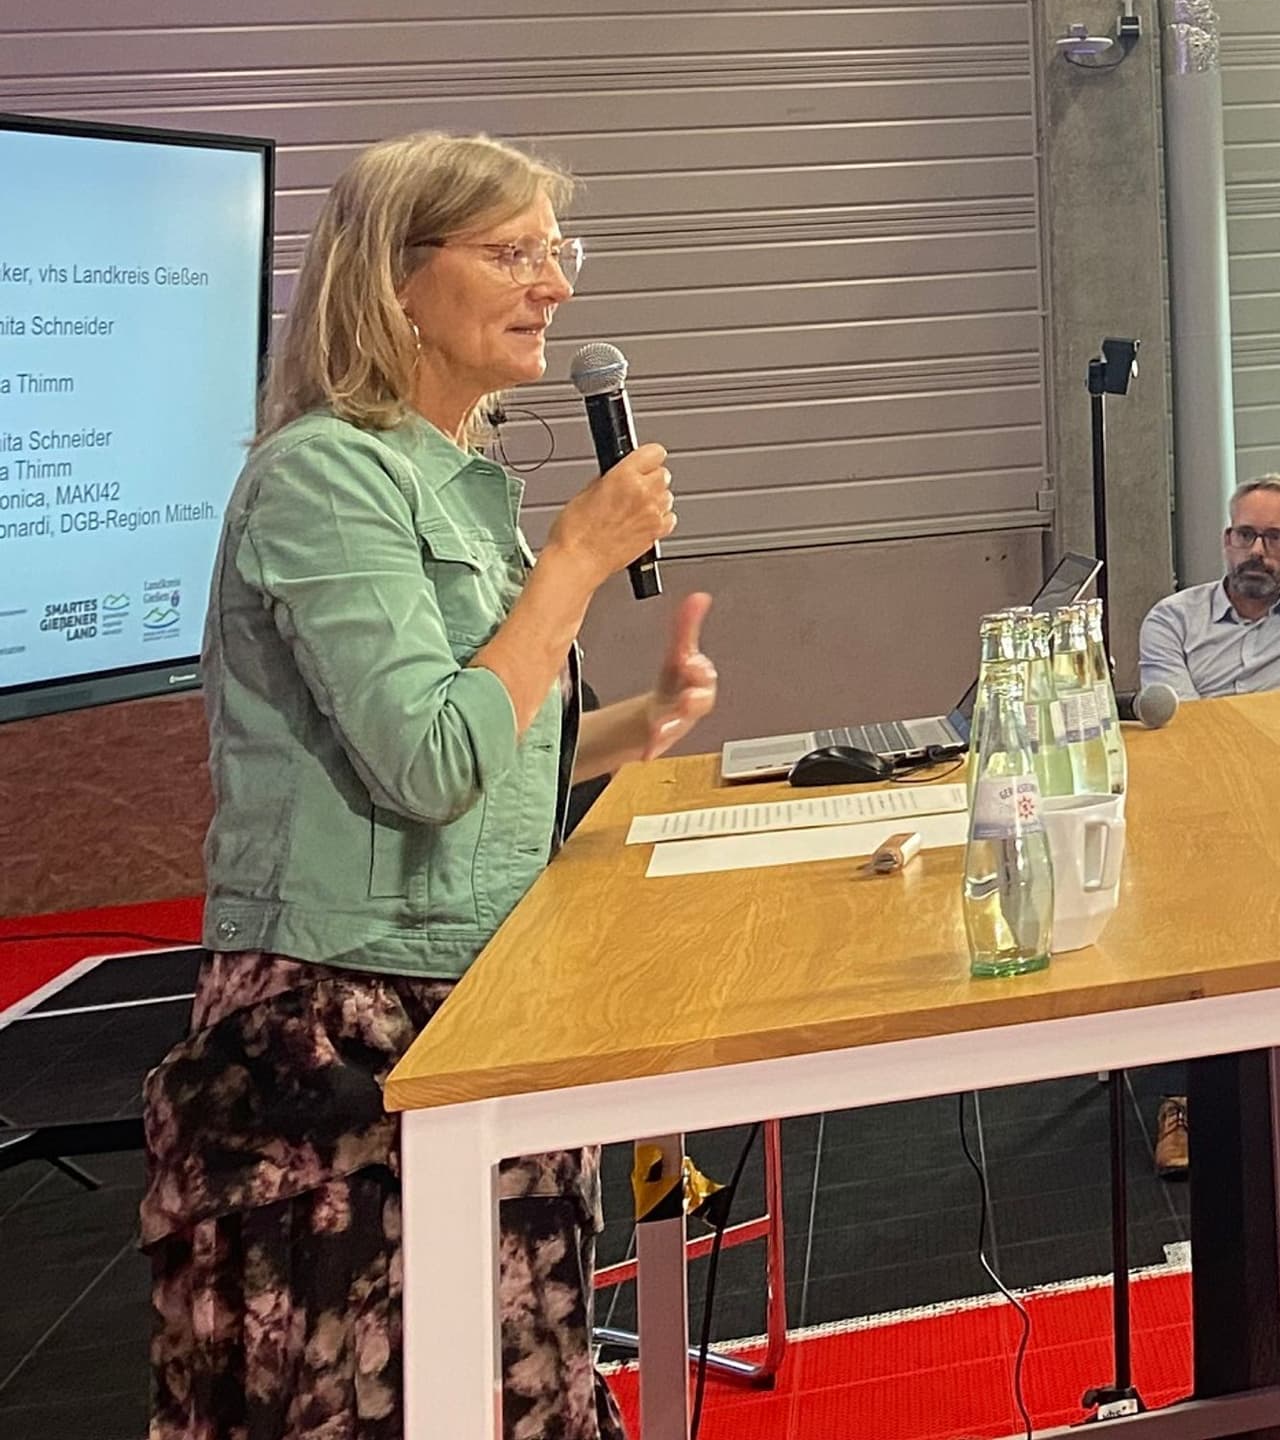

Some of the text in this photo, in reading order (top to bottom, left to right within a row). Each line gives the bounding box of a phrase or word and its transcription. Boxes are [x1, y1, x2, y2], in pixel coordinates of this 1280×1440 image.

[39, 264, 68, 283] vhs
[72, 265, 150, 285] Landkreis
[154, 267, 209, 286] Gießen
[31, 316, 114, 336] Schneider
[16, 374, 74, 394] Thimm
[28, 429, 112, 451] Schneider
[15, 460, 72, 481] Thimm
[56, 482, 120, 506] MAKI42
[61, 509, 161, 532] DGB-Region
[44, 598, 98, 617] SMARTES
[66, 627, 97, 641] LAND
